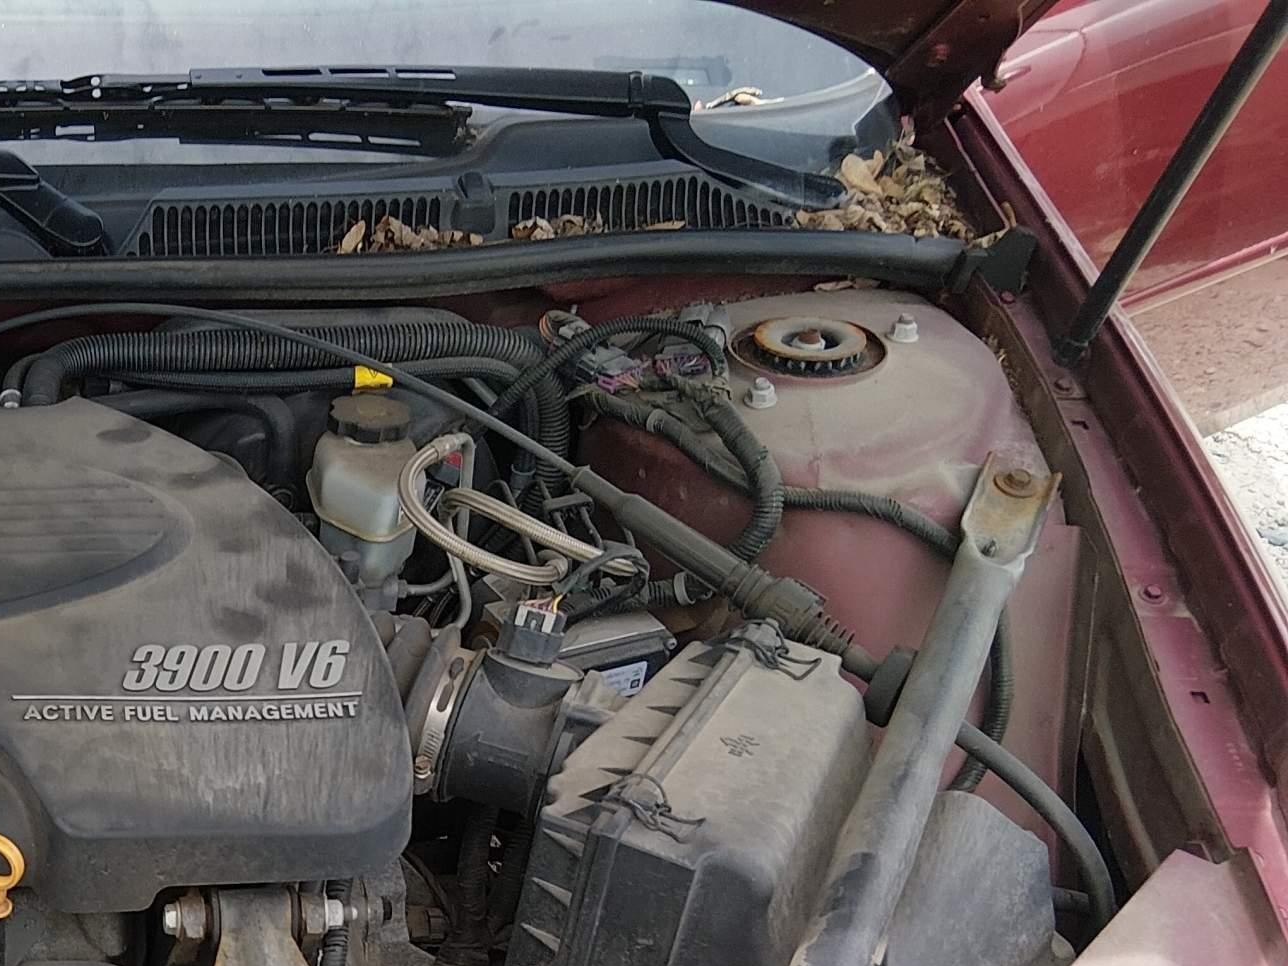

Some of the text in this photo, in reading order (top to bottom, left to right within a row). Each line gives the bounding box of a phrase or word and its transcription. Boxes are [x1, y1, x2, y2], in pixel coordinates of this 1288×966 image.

[122, 640, 350, 691] 3900 V6
[23, 701, 360, 722] ACTIVE FUEL MANAGEMENT
